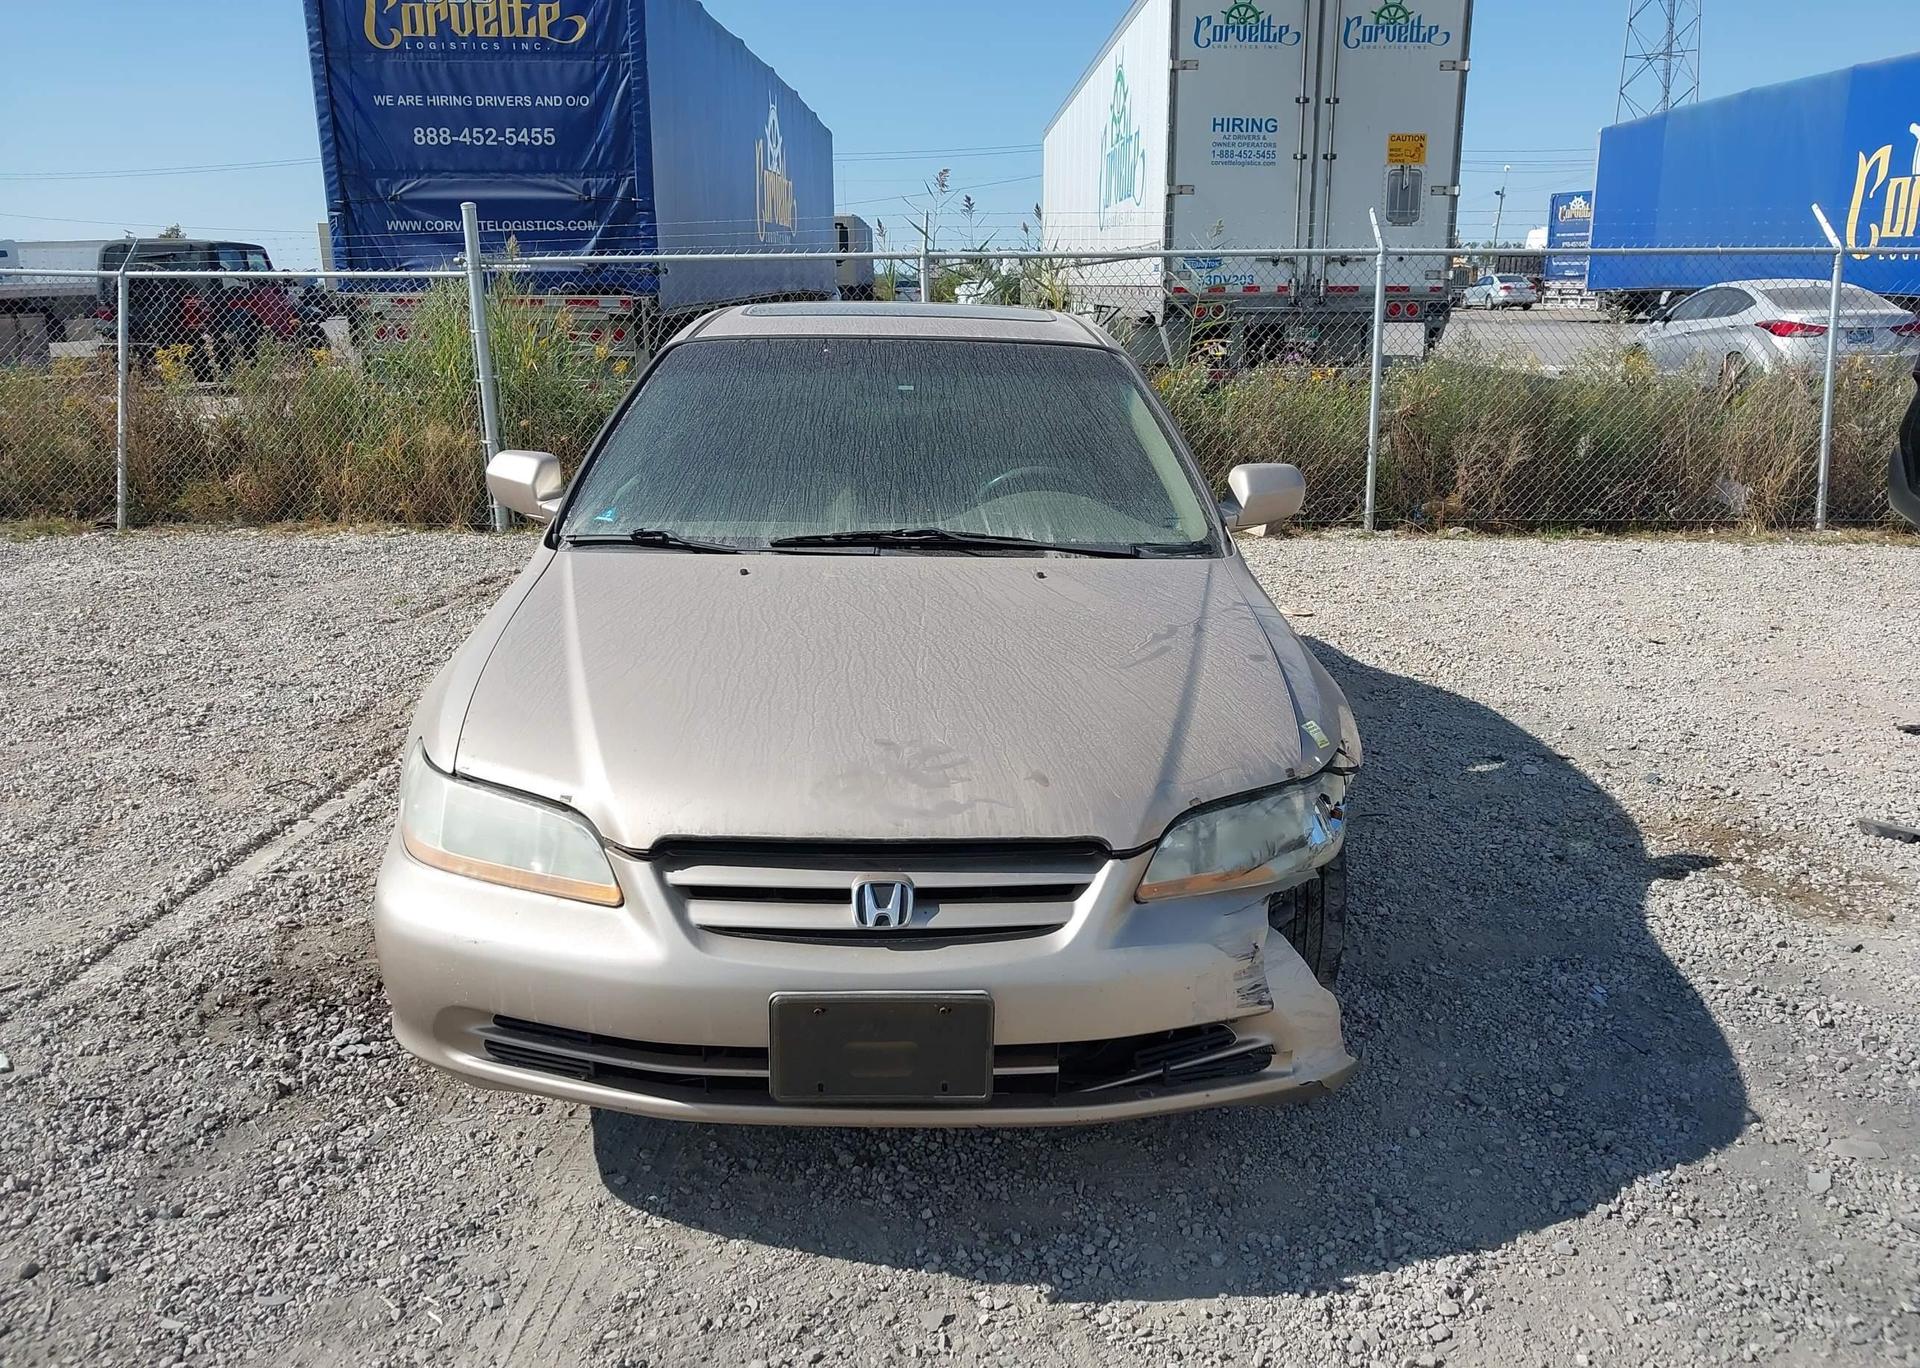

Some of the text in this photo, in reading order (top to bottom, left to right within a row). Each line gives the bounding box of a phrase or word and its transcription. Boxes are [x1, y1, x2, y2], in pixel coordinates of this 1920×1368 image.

[364, 0, 587, 49] Corvette
[1193, 14, 1301, 48] Corvette
[1343, 14, 1451, 49] Corvette
[405, 42, 551, 50] LOGISTICS INC.
[373, 95, 590, 107] WE ARE HIRING DRIVERS AND O/O
[1212, 117, 1278, 133] HIRING
[413, 127, 556, 146] 888-452-5455
[1211, 149, 1277, 159] 1-888-452-5455
[386, 219, 597, 232] WWW.CORVTELOGISTICS.COM
